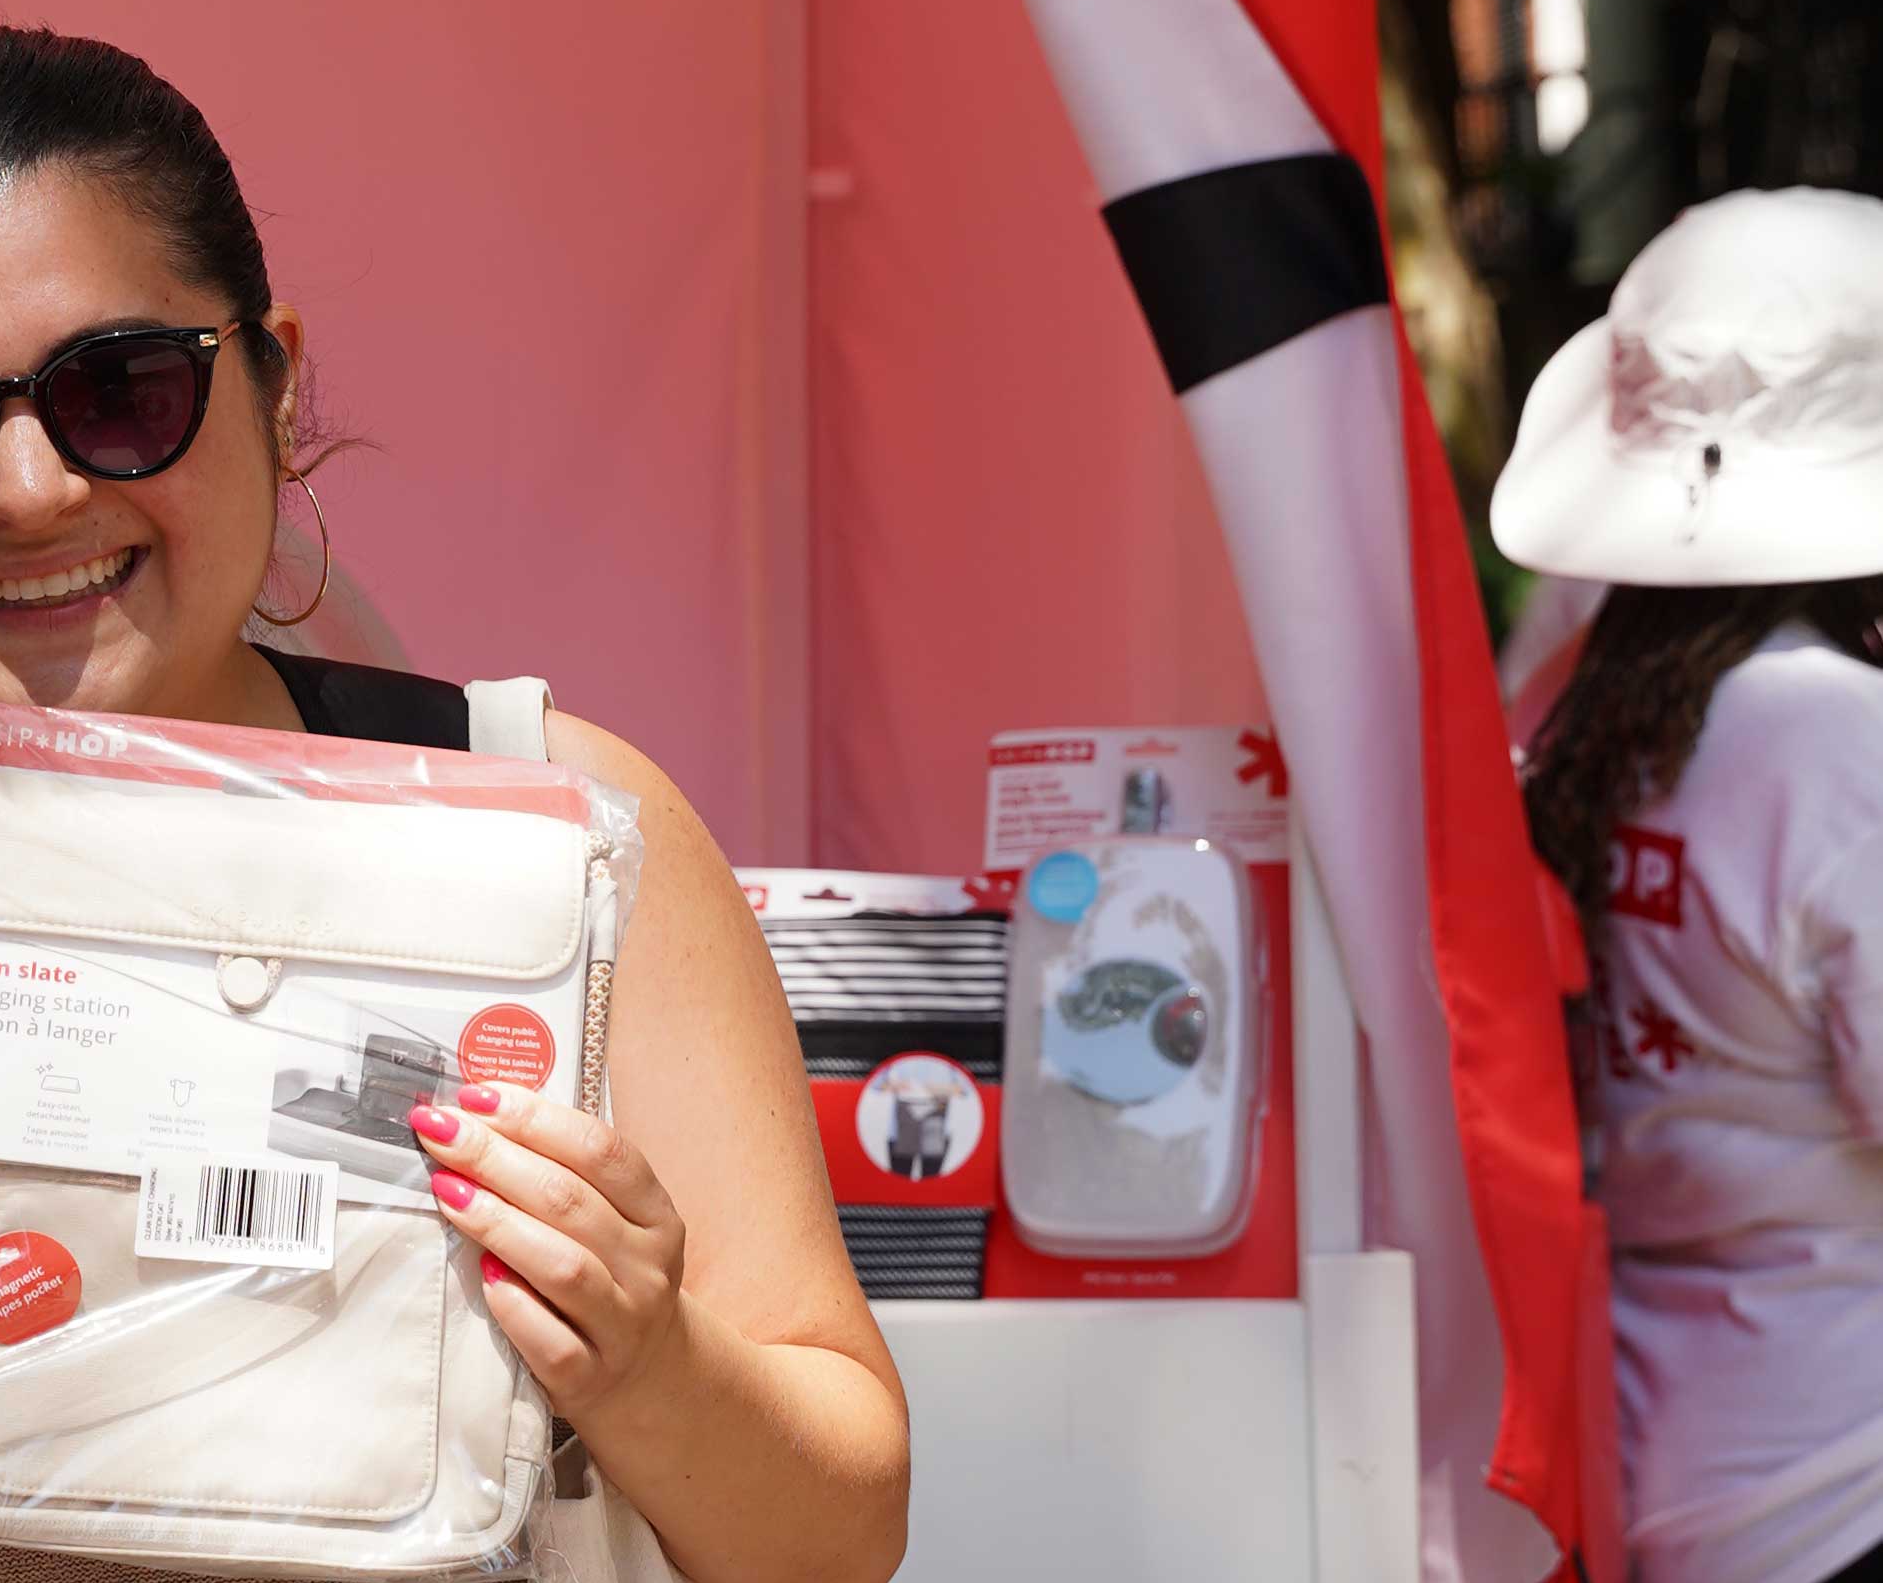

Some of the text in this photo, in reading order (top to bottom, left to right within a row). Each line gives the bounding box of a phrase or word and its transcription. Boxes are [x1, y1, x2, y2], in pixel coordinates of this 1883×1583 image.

[54, 730, 129, 759] HOP
[17, 962, 78, 984] slate
[53, 994, 130, 1018] station
[26, 1017, 39, 1036] à
[46, 1019, 118, 1047] langer
[476, 1034, 542, 1049] changing tables
[482, 1023, 538, 1037] Covers public
[498, 1056, 511, 1066] les
[512, 1059, 537, 1069] tables
[23, 1275, 64, 1309] pocket
